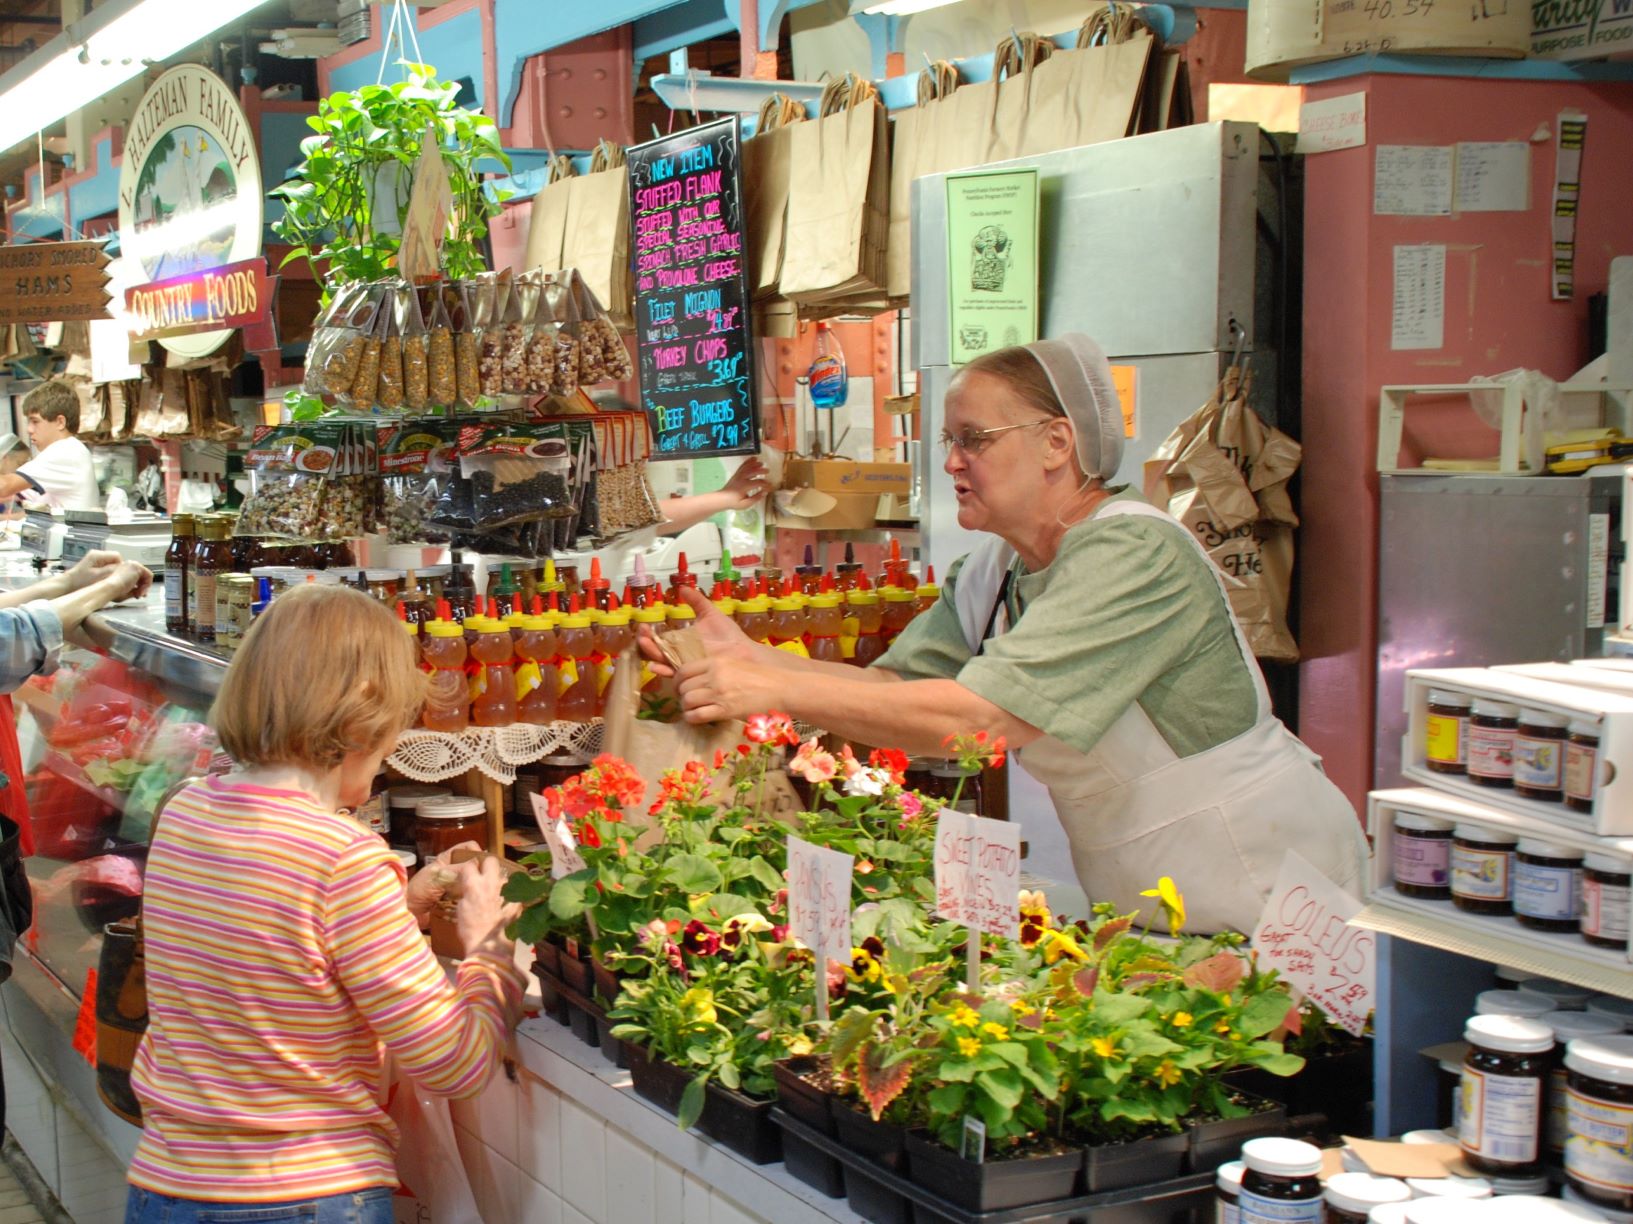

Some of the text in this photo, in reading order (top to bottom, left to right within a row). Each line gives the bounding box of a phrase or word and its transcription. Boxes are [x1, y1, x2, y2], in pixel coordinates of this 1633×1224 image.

[127, 75, 188, 171] HALTEMAN
[199, 77, 249, 169] FAMILY
[651, 143, 713, 182] NEW ITEM
[635, 170, 722, 215] STUFFED FLANK
[636, 199, 720, 236] STUFFED WITH OUR
[51, 247, 97, 266] SMOKED
[637, 230, 673, 256] SPECIAL
[674, 239, 707, 264] FRESH
[710, 231, 741, 254] GARLIC
[15, 273, 73, 297] HAMS
[131, 269, 257, 336] COUNTRY FOODS
[647, 288, 722, 322] FILET MIGNON
[652, 337, 728, 371] TURKEY CHOPS
[654, 398, 735, 434] BEEF BURGERS
[1278, 885, 1374, 975] COLEUS
